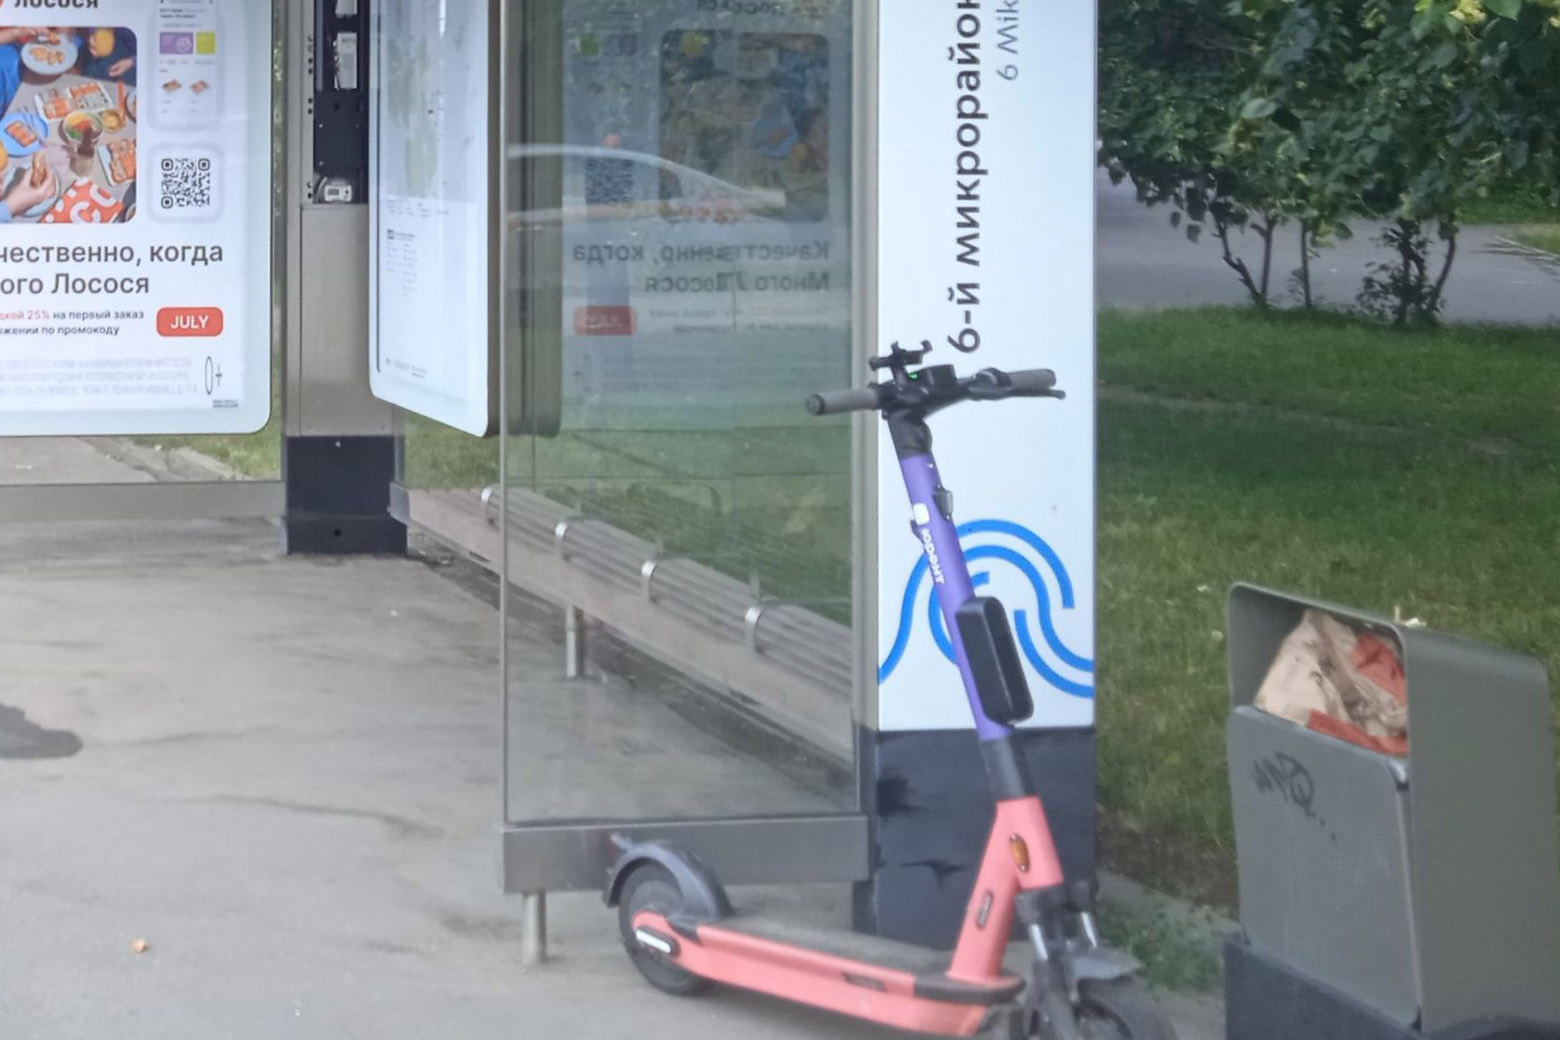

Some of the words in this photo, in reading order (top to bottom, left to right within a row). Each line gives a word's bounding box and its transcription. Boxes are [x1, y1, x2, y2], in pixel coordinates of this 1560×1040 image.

[996, 63, 1020, 81] 6
[150, 244, 224, 266] когда
[51, 272, 150, 294] Лосося
[26, 311, 51, 321] 25%
[53, 311, 67, 320] на
[68, 310, 111, 322] первый
[113, 311, 144, 320] заказ
[170, 315, 210, 330] JULY
[946, 282, 982, 354] 6-й
[41, 326, 55, 336] по
[57, 325, 120, 337] промокоду
